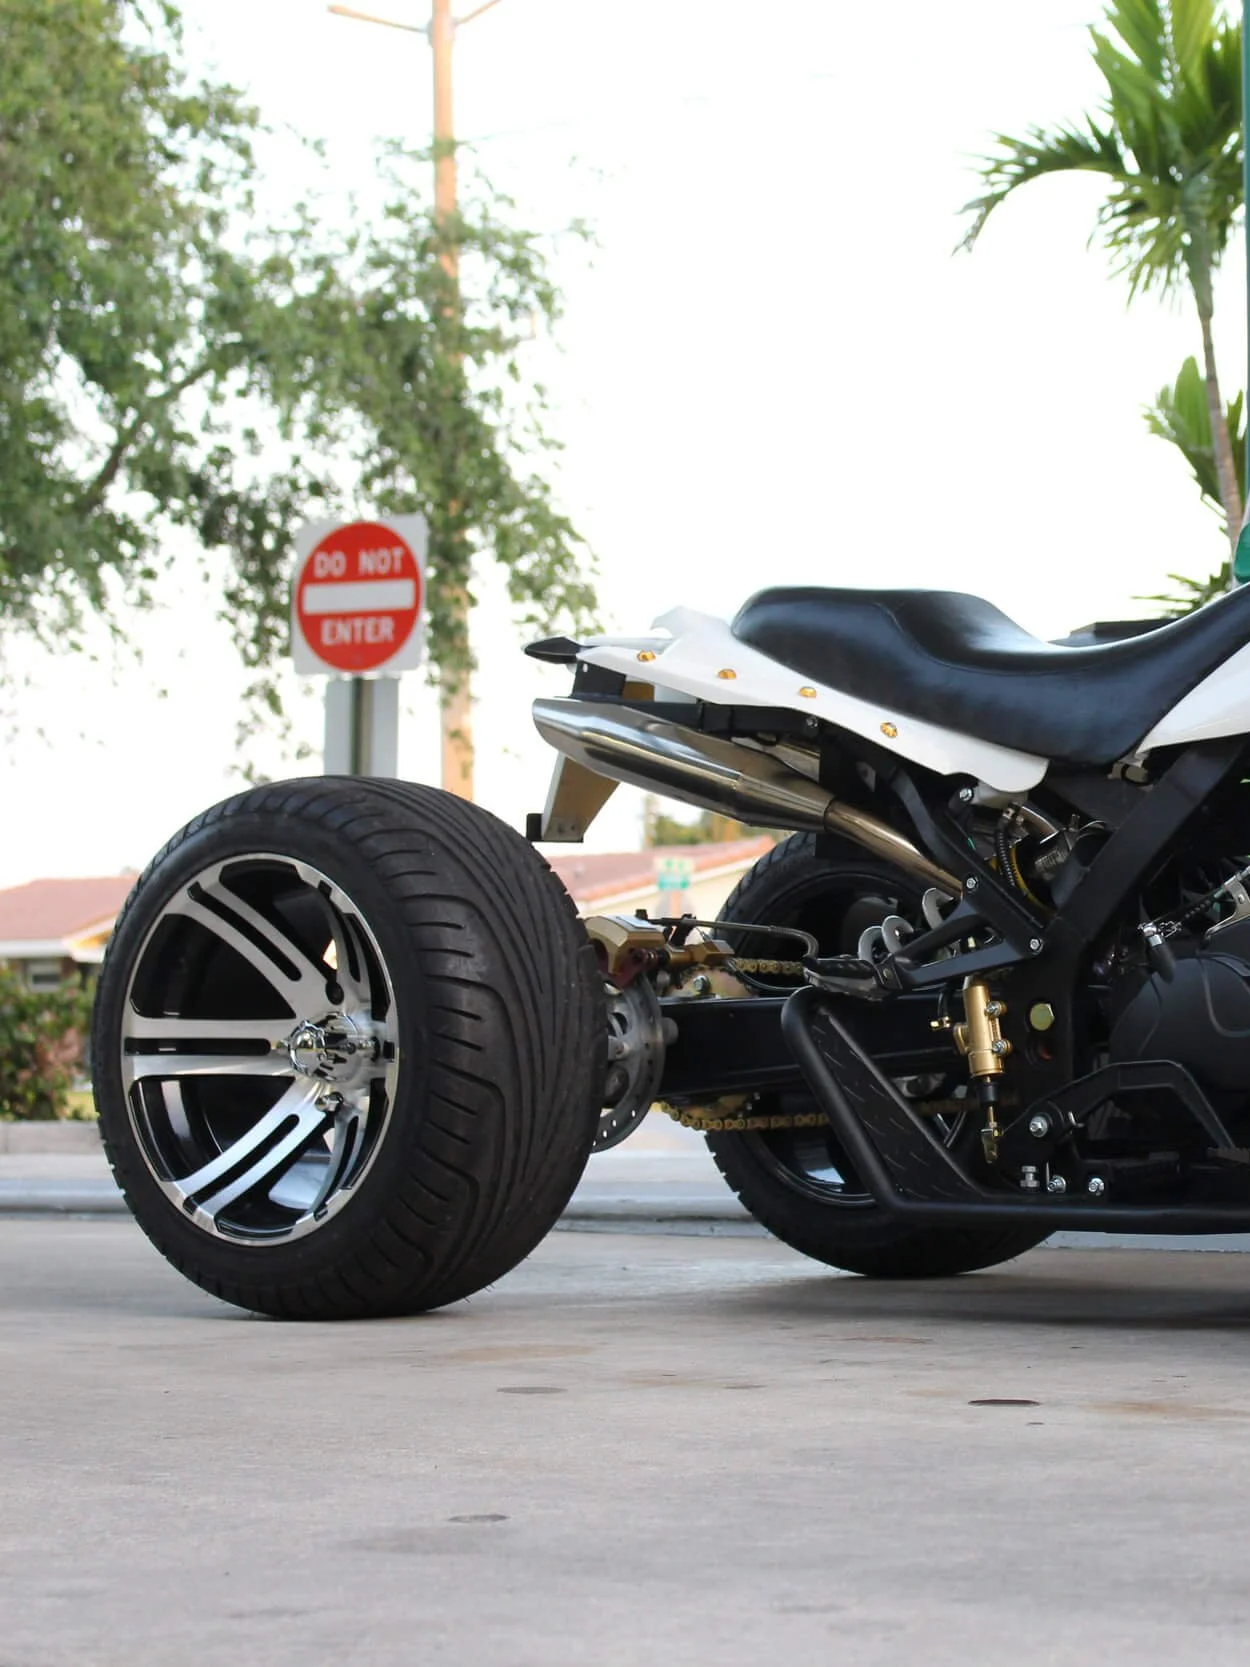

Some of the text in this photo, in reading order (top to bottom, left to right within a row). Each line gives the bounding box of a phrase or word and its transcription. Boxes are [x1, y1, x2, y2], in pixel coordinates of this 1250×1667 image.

[314, 547, 404, 577] DO NOT
[320, 616, 396, 646] ENTER
